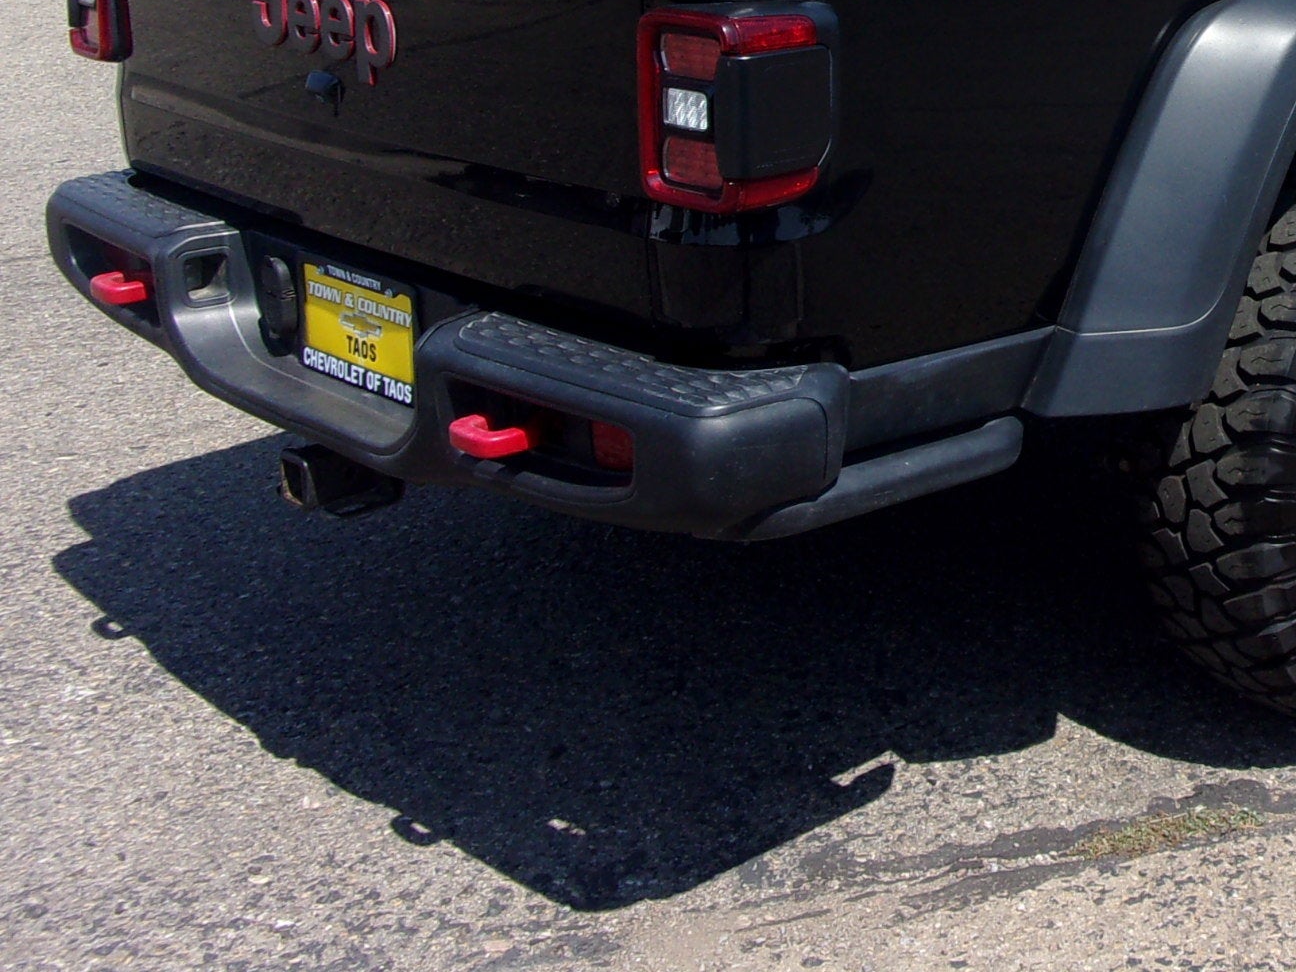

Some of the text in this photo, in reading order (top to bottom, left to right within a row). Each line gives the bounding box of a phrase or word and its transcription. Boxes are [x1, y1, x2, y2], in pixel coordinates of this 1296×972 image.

[326, 264, 346, 280] TOWN
[353, 274, 382, 291] COUNTRY
[308, 281, 413, 328] TOWN & COUNTRY
[346, 335, 377, 362] TAOS
[303, 346, 412, 404] CHEVROLET OF TAOS
